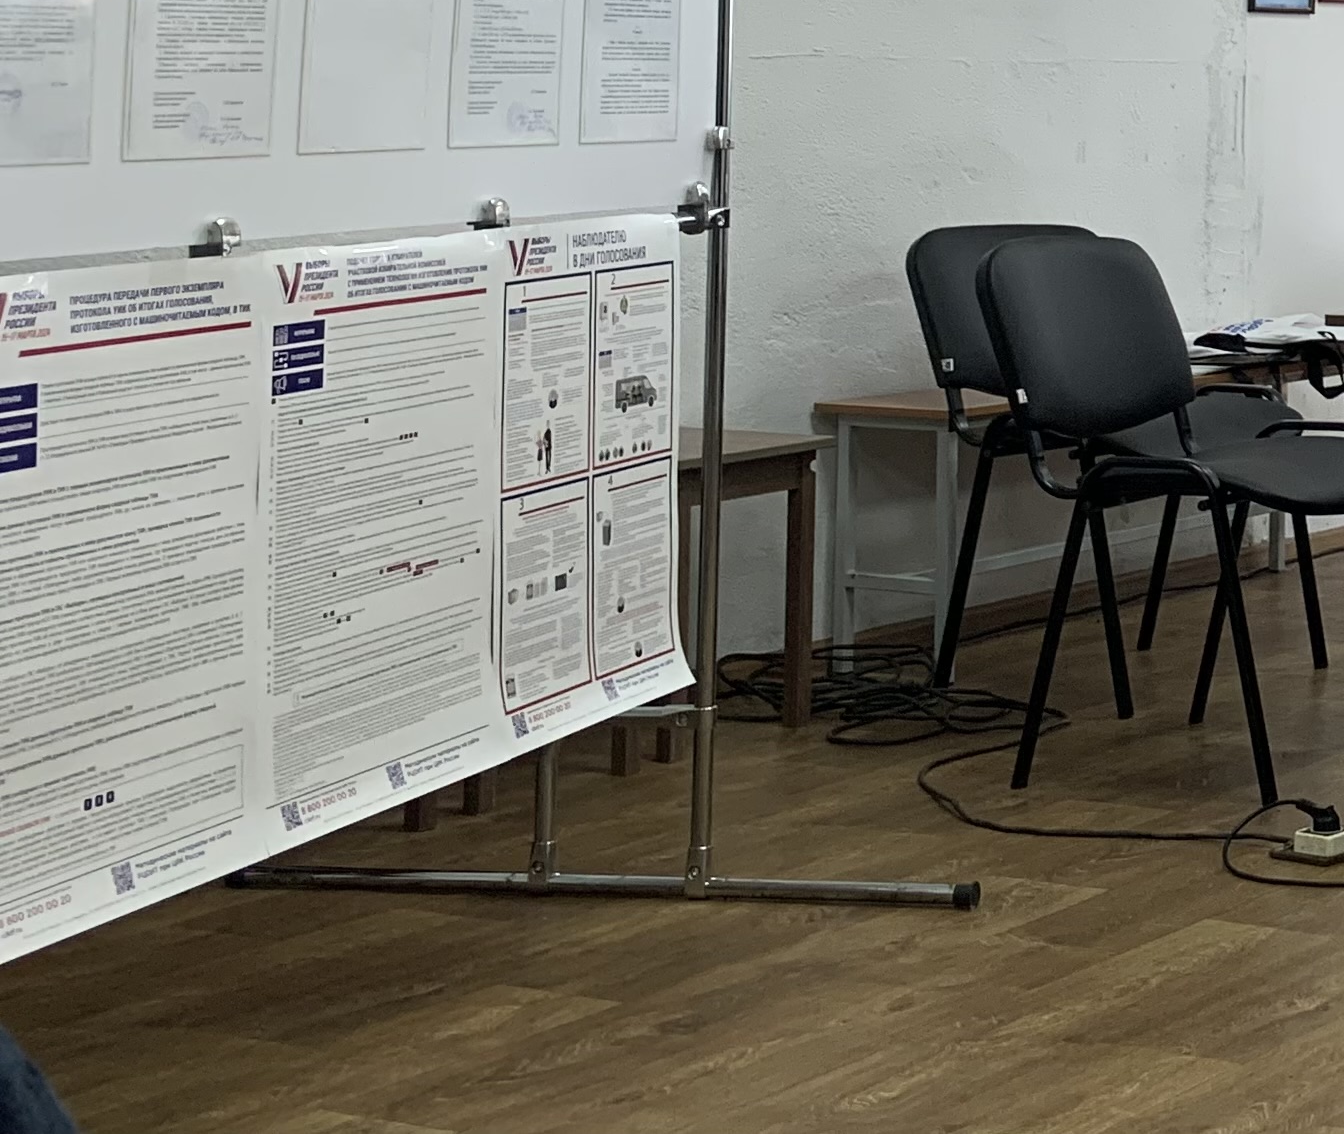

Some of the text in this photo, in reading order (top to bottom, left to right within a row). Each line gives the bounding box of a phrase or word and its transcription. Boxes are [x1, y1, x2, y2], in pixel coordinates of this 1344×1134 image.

[572, 229, 627, 249] НАБЛЮДАТЕЛЮ
[573, 246, 646, 268] В ДНИ ГОЛОСОВАНИЯ
[611, 273, 616, 285] 2
[69, 281, 224, 305] ПРОЦЕДУРА ПЕРЕДАЧИ ПЕРВОГО ЭКЗЕМПЛЯРА
[8, 301, 57, 316] ПРЕЗИДЕНТА
[69, 295, 214, 319] ПРОТОКОЛА УИК ОБ ИТОГАХ ГОЛОСОВАНИЯ,
[4, 316, 37, 329] РОССИИ
[70, 318, 132, 334] ИЗГОТОВЛЕННОГО
[133, 316, 139, 327] С
[140, 309, 207, 325] МАШИНОЧИТАЕМЫМ
[608, 475, 613, 486] 4
[519, 498, 524, 511] 3
[322, 794, 336, 807] 200
[336, 790, 347, 801] 00
[347, 786, 358, 797] 20
[27, 903, 44, 919] 200
[46, 898, 59, 910] 00
[60, 894, 72, 906] 20
